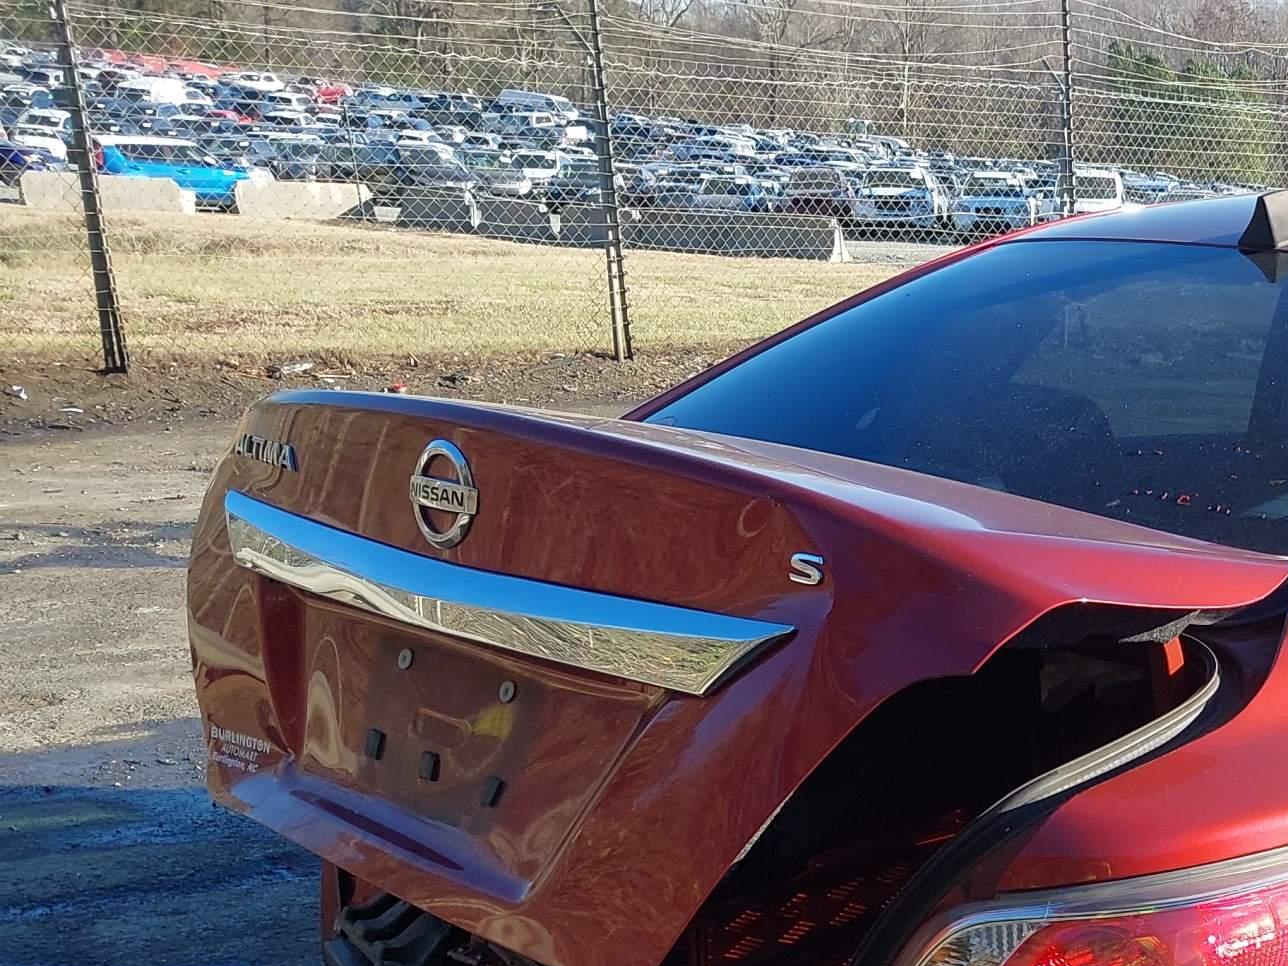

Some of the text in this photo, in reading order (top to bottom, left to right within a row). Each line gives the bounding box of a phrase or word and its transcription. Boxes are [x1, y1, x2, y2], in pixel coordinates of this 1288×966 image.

[235, 433, 297, 472] ALTIMA
[411, 482, 464, 507] NISSAN
[788, 552, 824, 585] S
[211, 726, 271, 755] BURLINGTON
[221, 743, 258, 762] AUTOMART
[246, 763, 259, 774] NC
